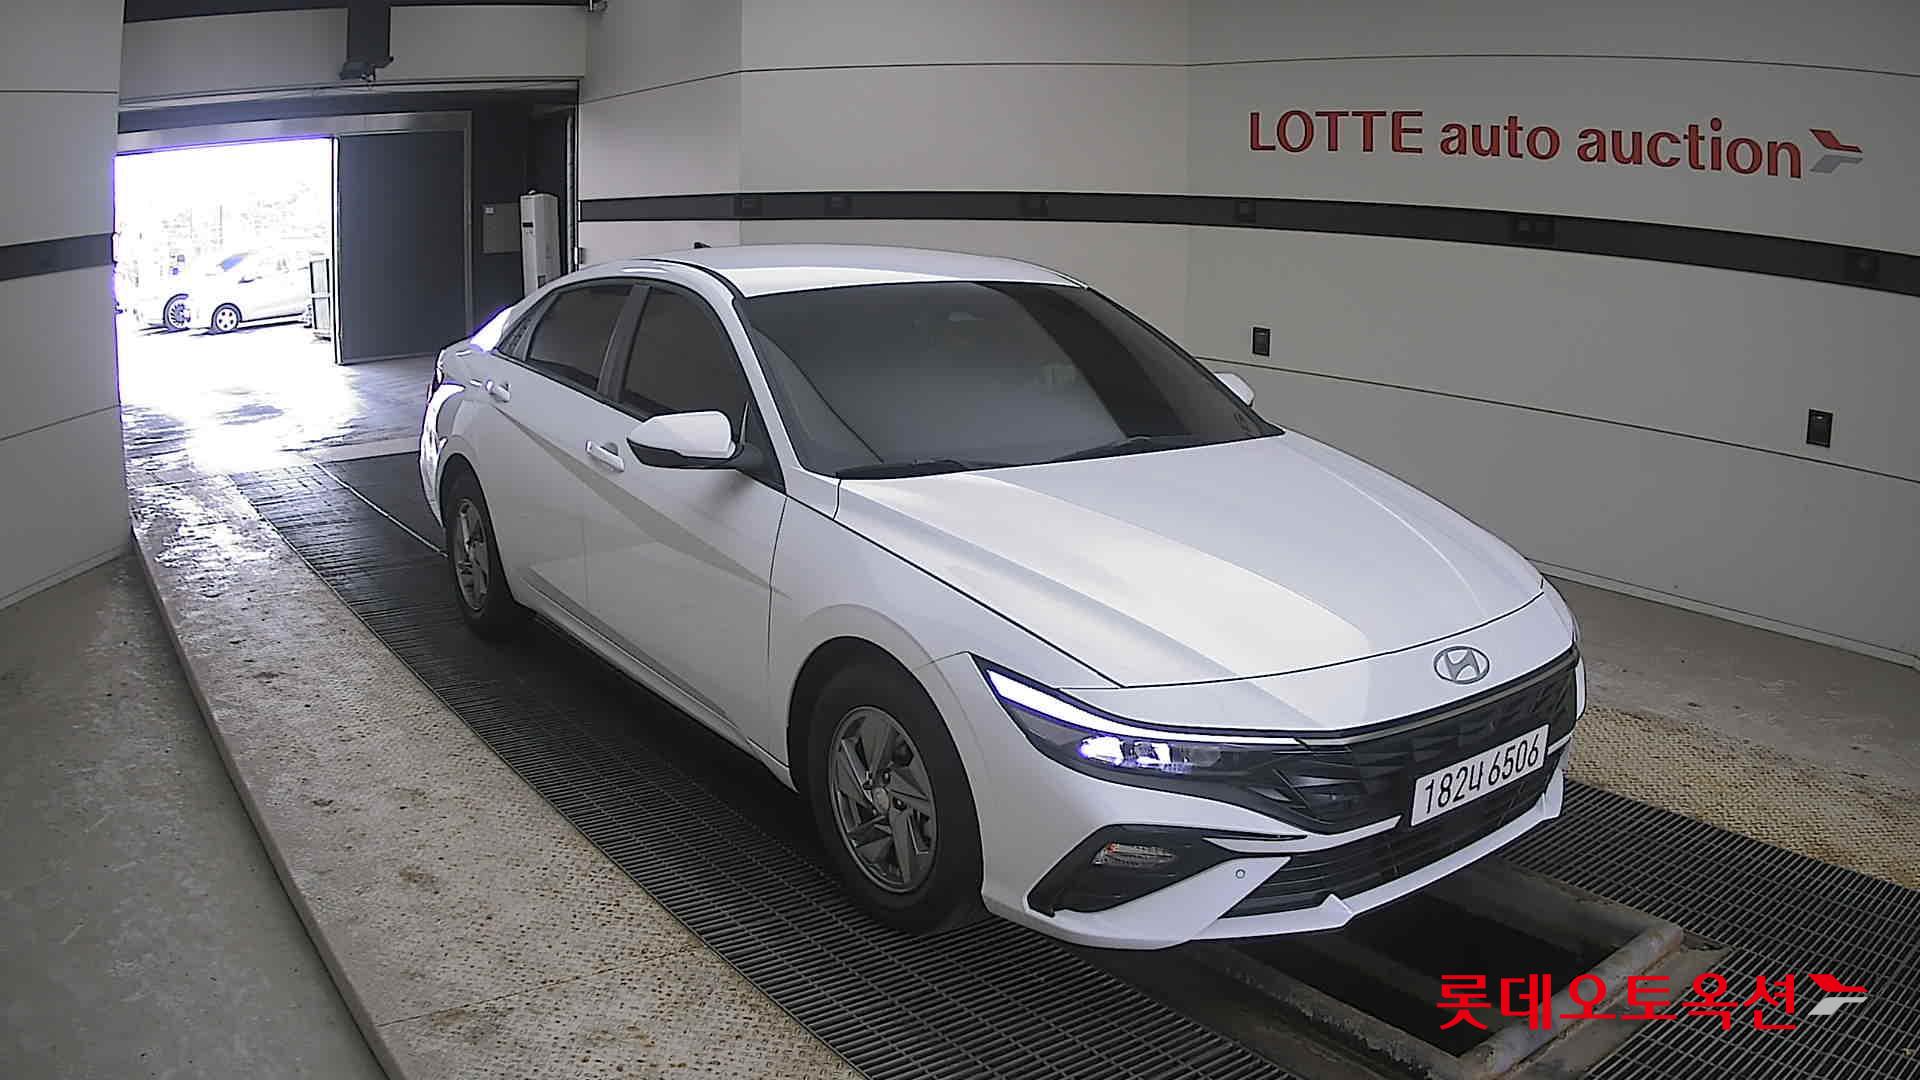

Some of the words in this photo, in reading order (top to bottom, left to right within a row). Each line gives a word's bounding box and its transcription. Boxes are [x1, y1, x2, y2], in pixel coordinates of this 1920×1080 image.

[1250, 111, 1424, 154] LOTTE
[1440, 116, 1561, 158] auto
[1576, 118, 1802, 178] auction
[1488, 733, 1539, 786] 6506
